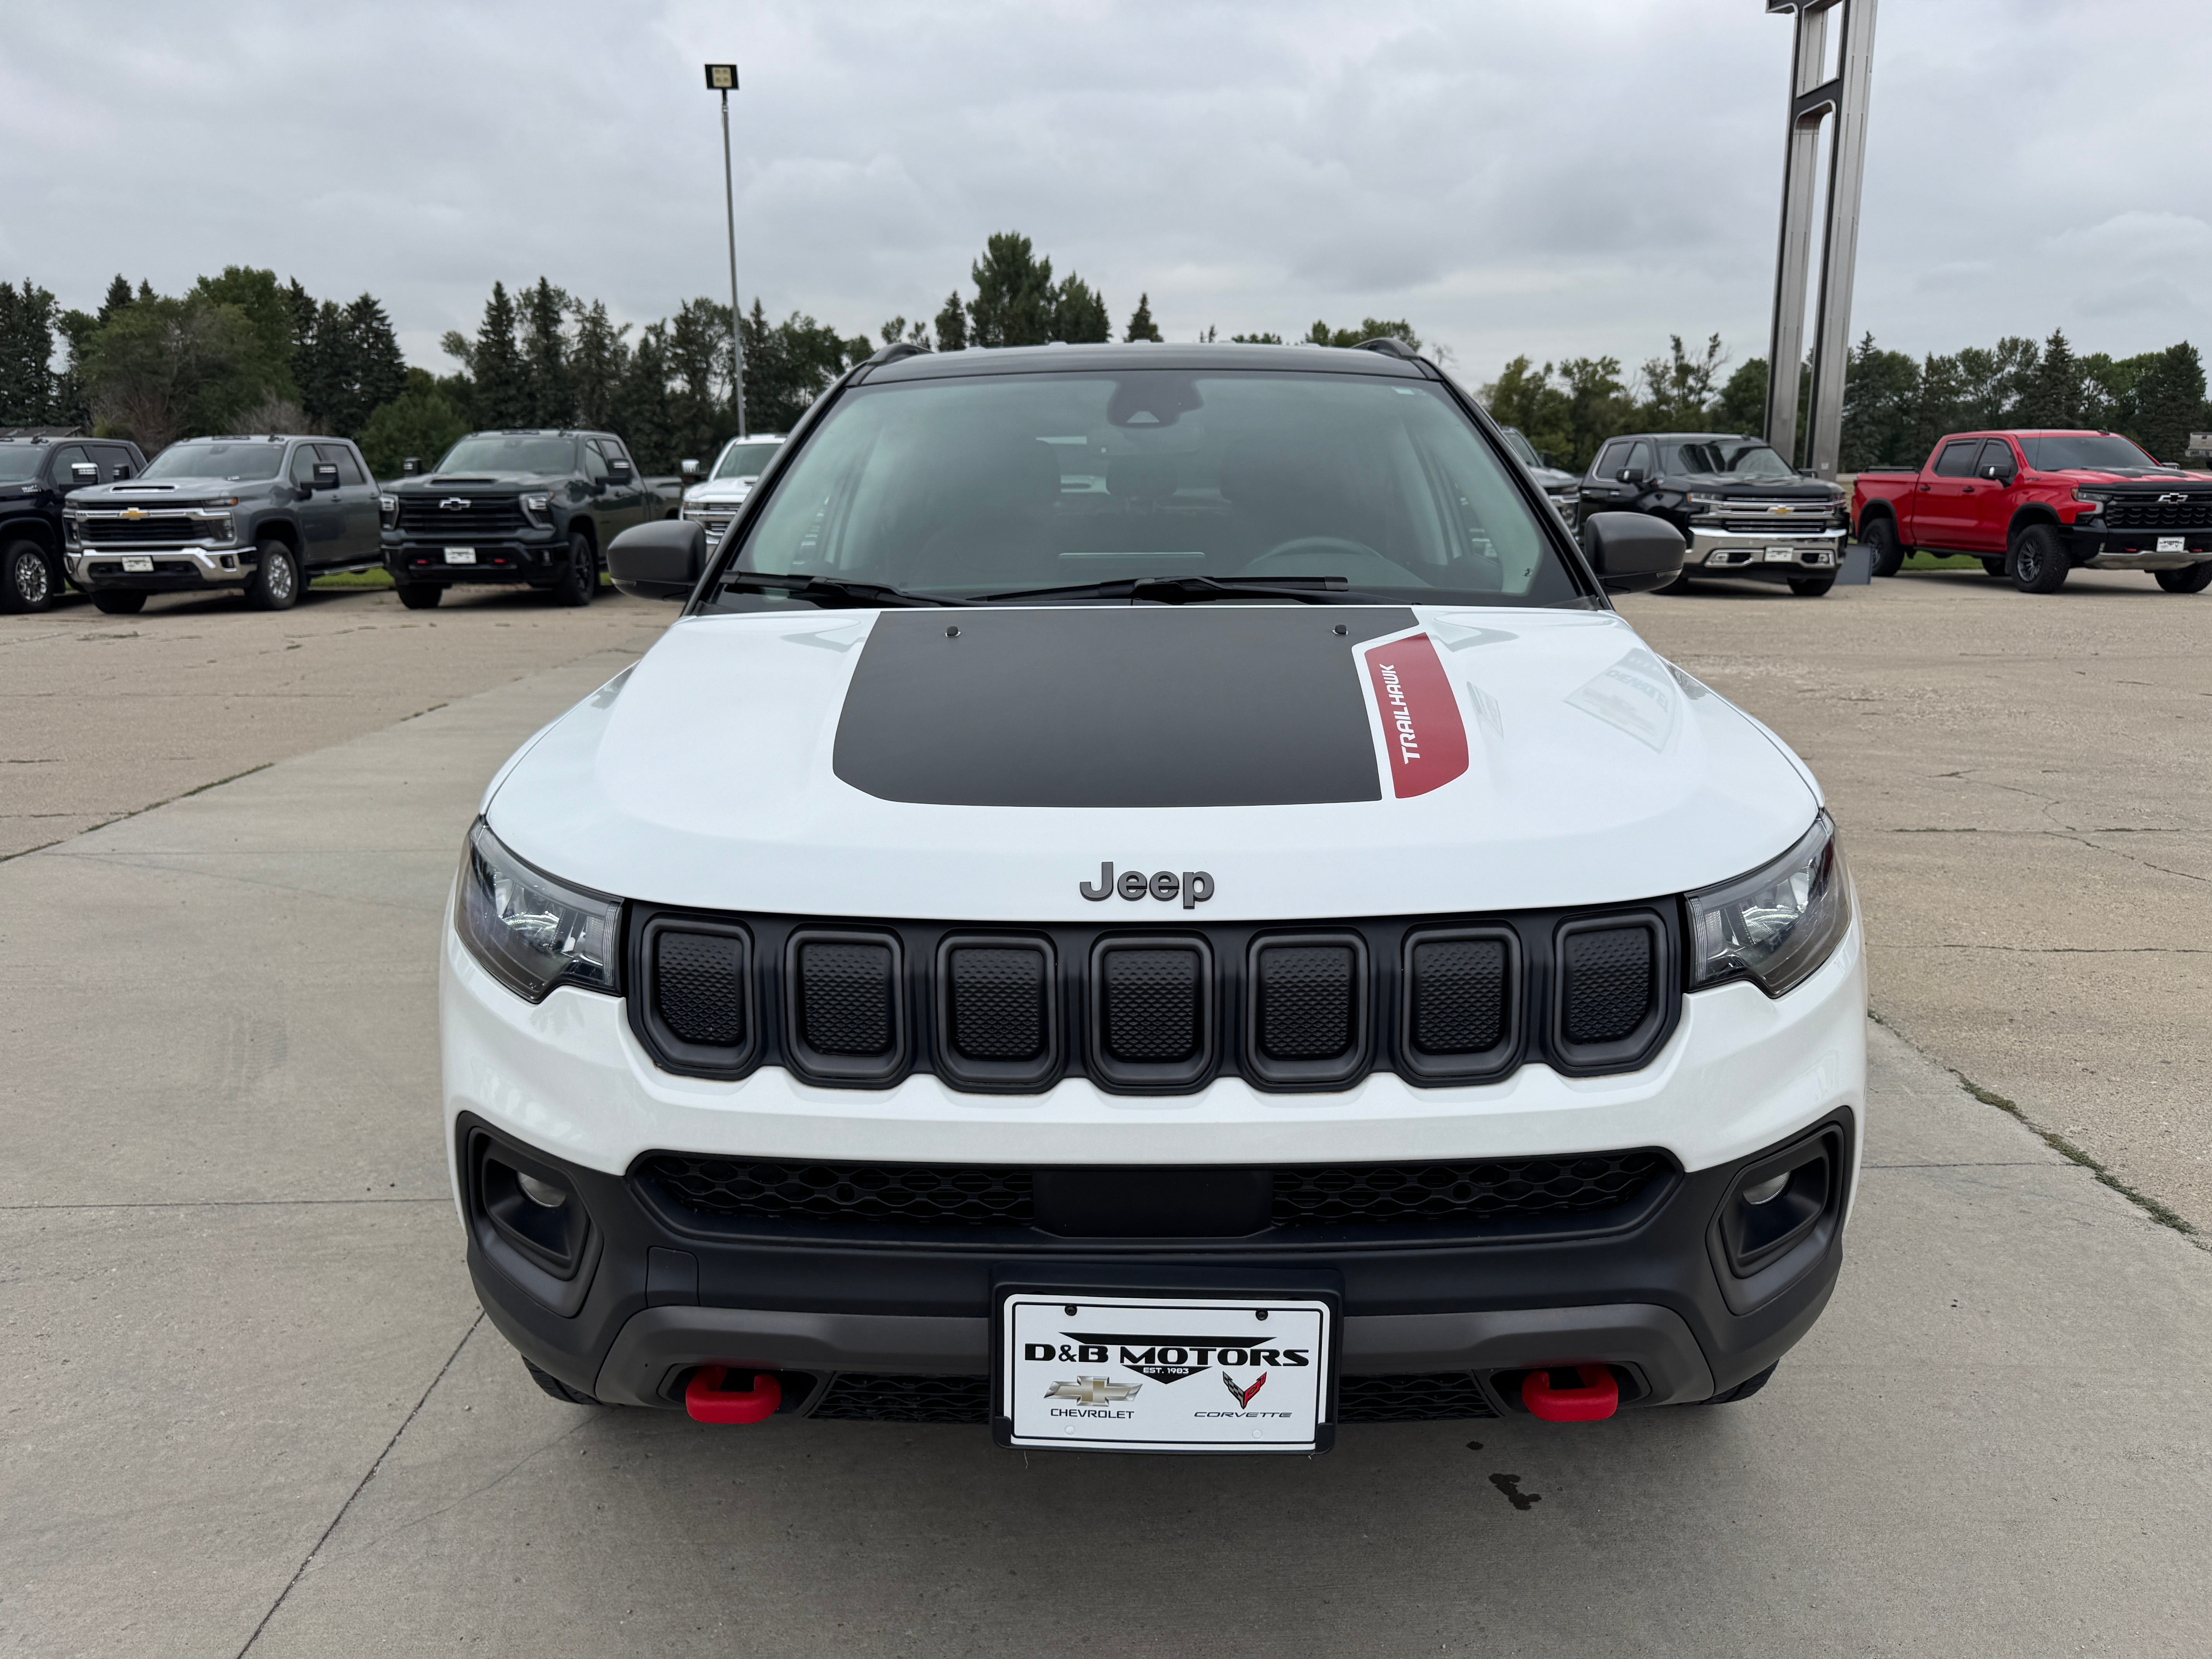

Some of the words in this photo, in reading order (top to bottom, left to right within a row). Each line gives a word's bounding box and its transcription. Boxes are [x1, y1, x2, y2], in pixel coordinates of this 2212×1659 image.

[1379, 663, 1420, 765] TRAILHAWK
[1079, 861, 1215, 910] Jeep
[1025, 1343, 1109, 1363] D&B
[1120, 1346, 1309, 1367] MOTORS
[1050, 1408, 1135, 1419] CHEVROLET
